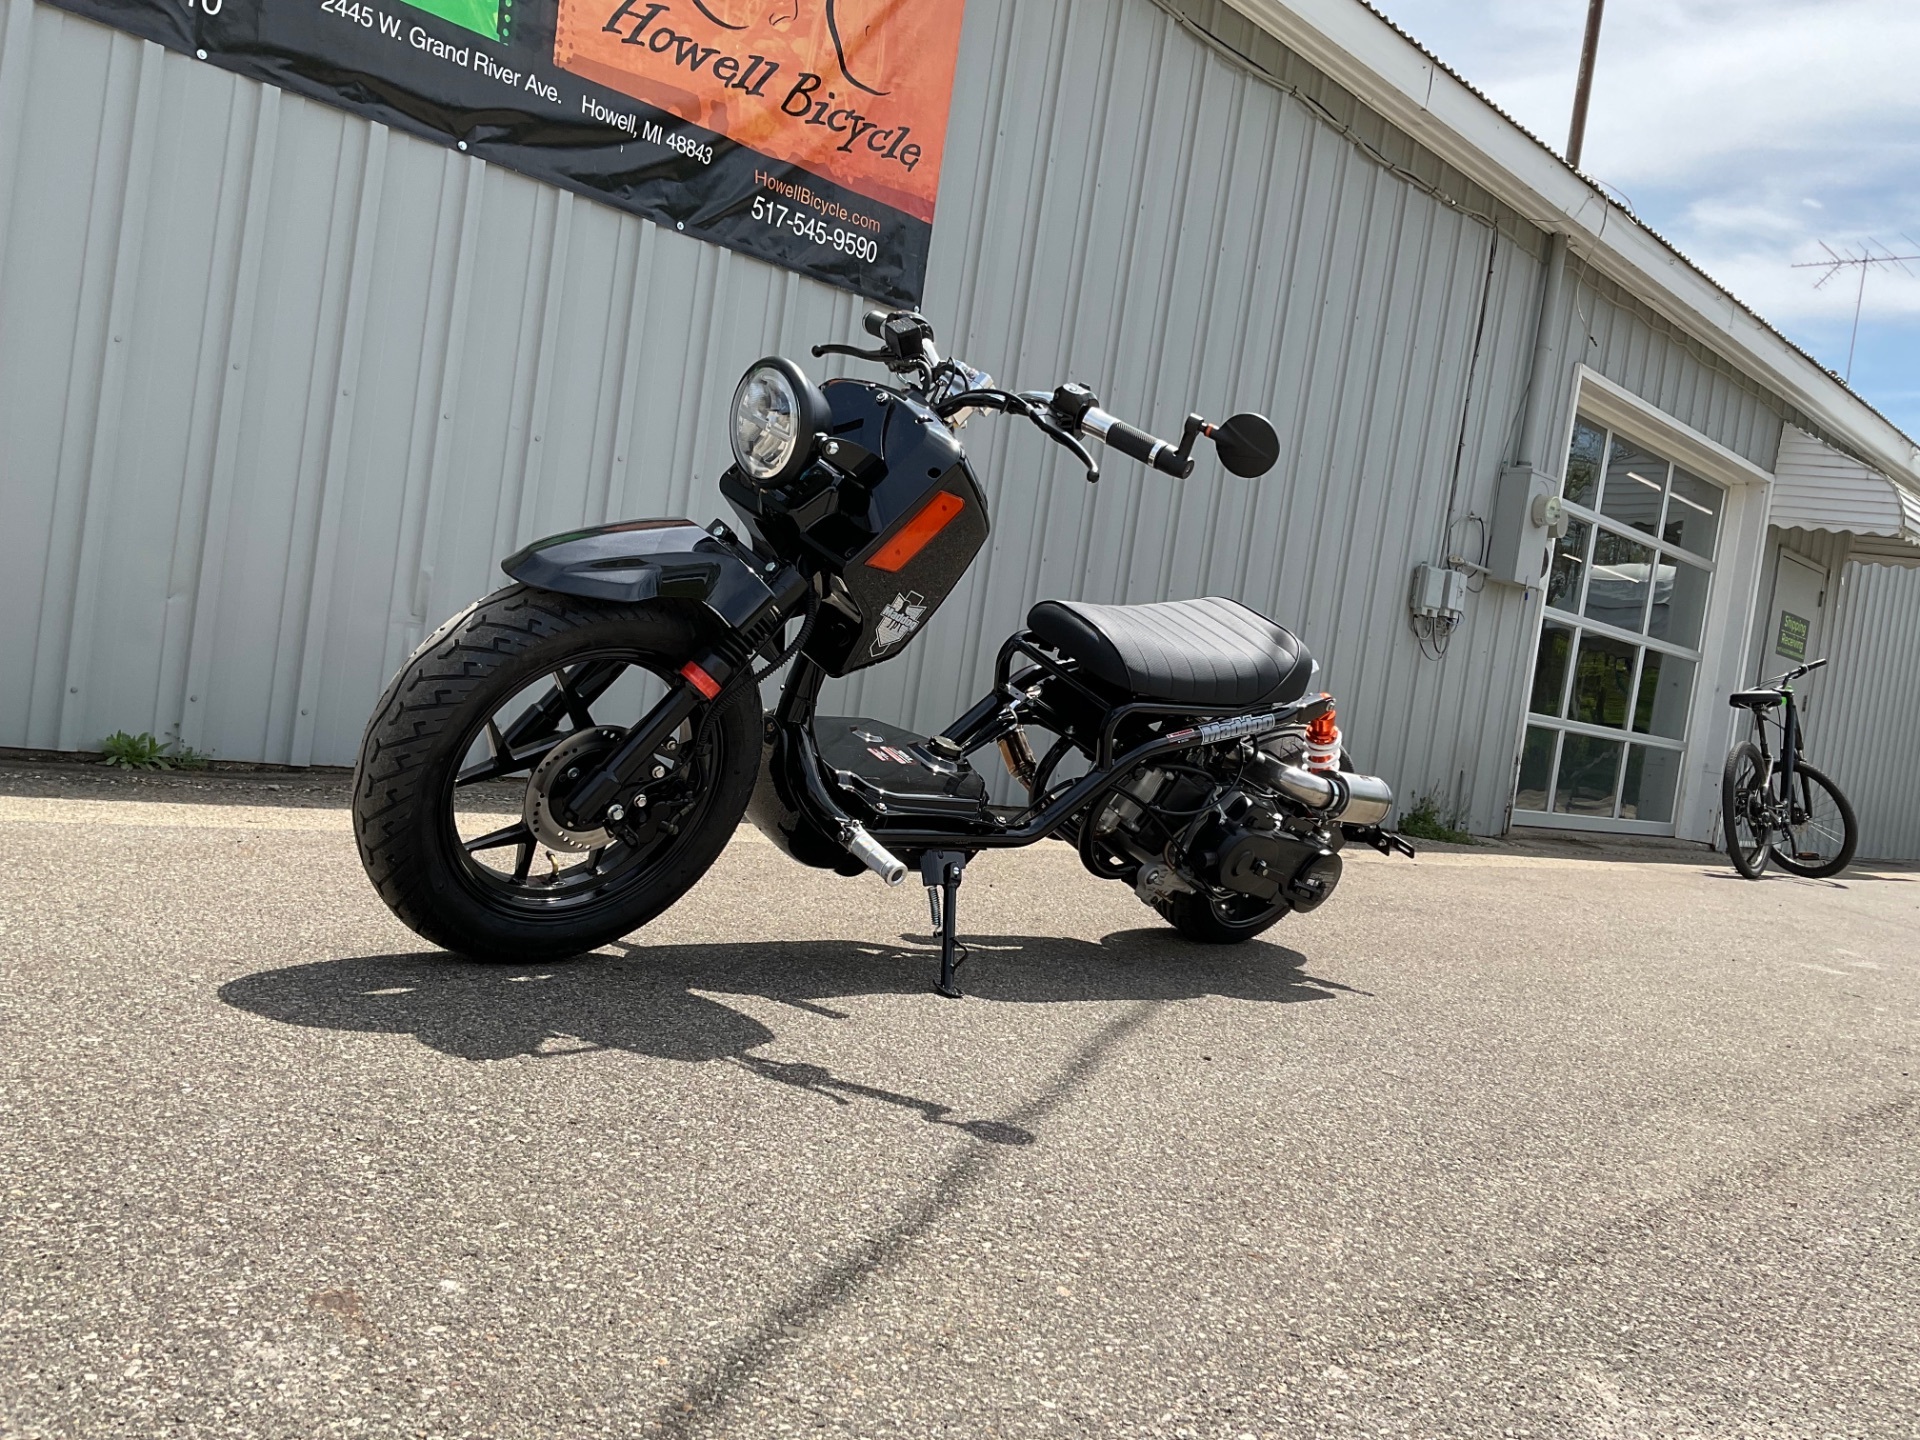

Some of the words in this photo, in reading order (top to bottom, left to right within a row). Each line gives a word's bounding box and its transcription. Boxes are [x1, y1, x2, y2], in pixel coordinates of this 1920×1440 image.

[321, 0, 373, 28] 2445
[379, 11, 402, 41] W.
[409, 26, 469, 67] Grand
[473, 51, 521, 87] River
[524, 74, 562, 104] Ave.
[581, 95, 638, 139] Howell,
[642, 120, 663, 145] MI
[666, 132, 713, 165] 48843
[602, 0, 779, 97] Howell
[780, 72, 922, 172] Bicycle
[751, 196, 878, 263] 517-545-9590
[754, 169, 881, 233] HowellBicycle.com
[1781, 632, 1804, 653] Receiving
[1784, 615, 1807, 637] Shipping
